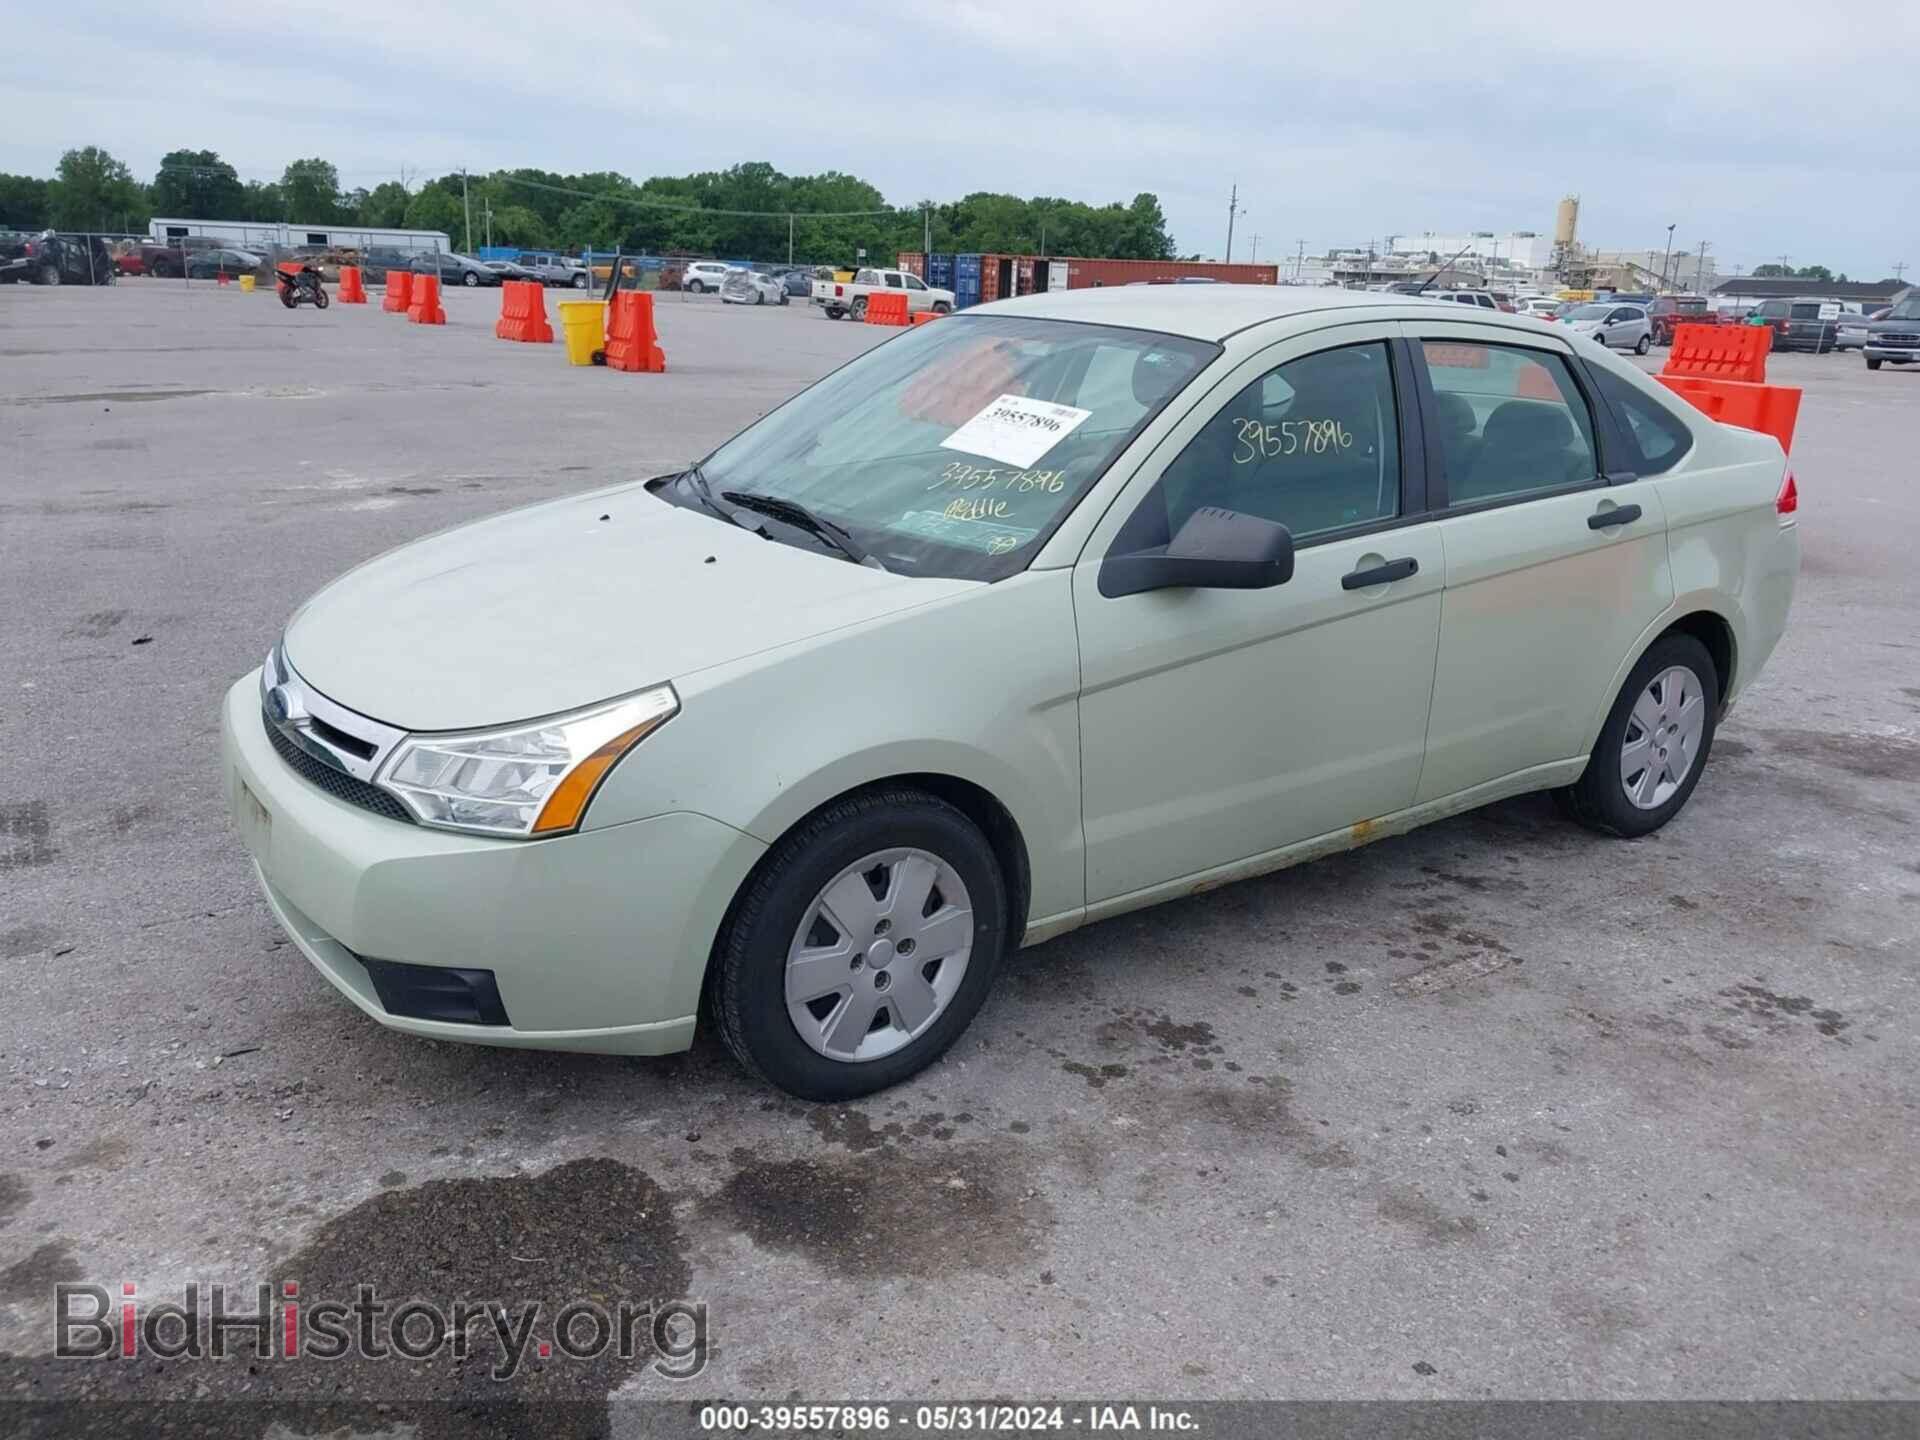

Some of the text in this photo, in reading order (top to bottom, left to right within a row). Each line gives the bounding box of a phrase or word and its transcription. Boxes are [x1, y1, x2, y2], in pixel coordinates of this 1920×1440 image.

[992, 406, 1061, 432] 39557896
[1232, 417, 1352, 464] 39557896
[927, 462, 1065, 493] 39557896
